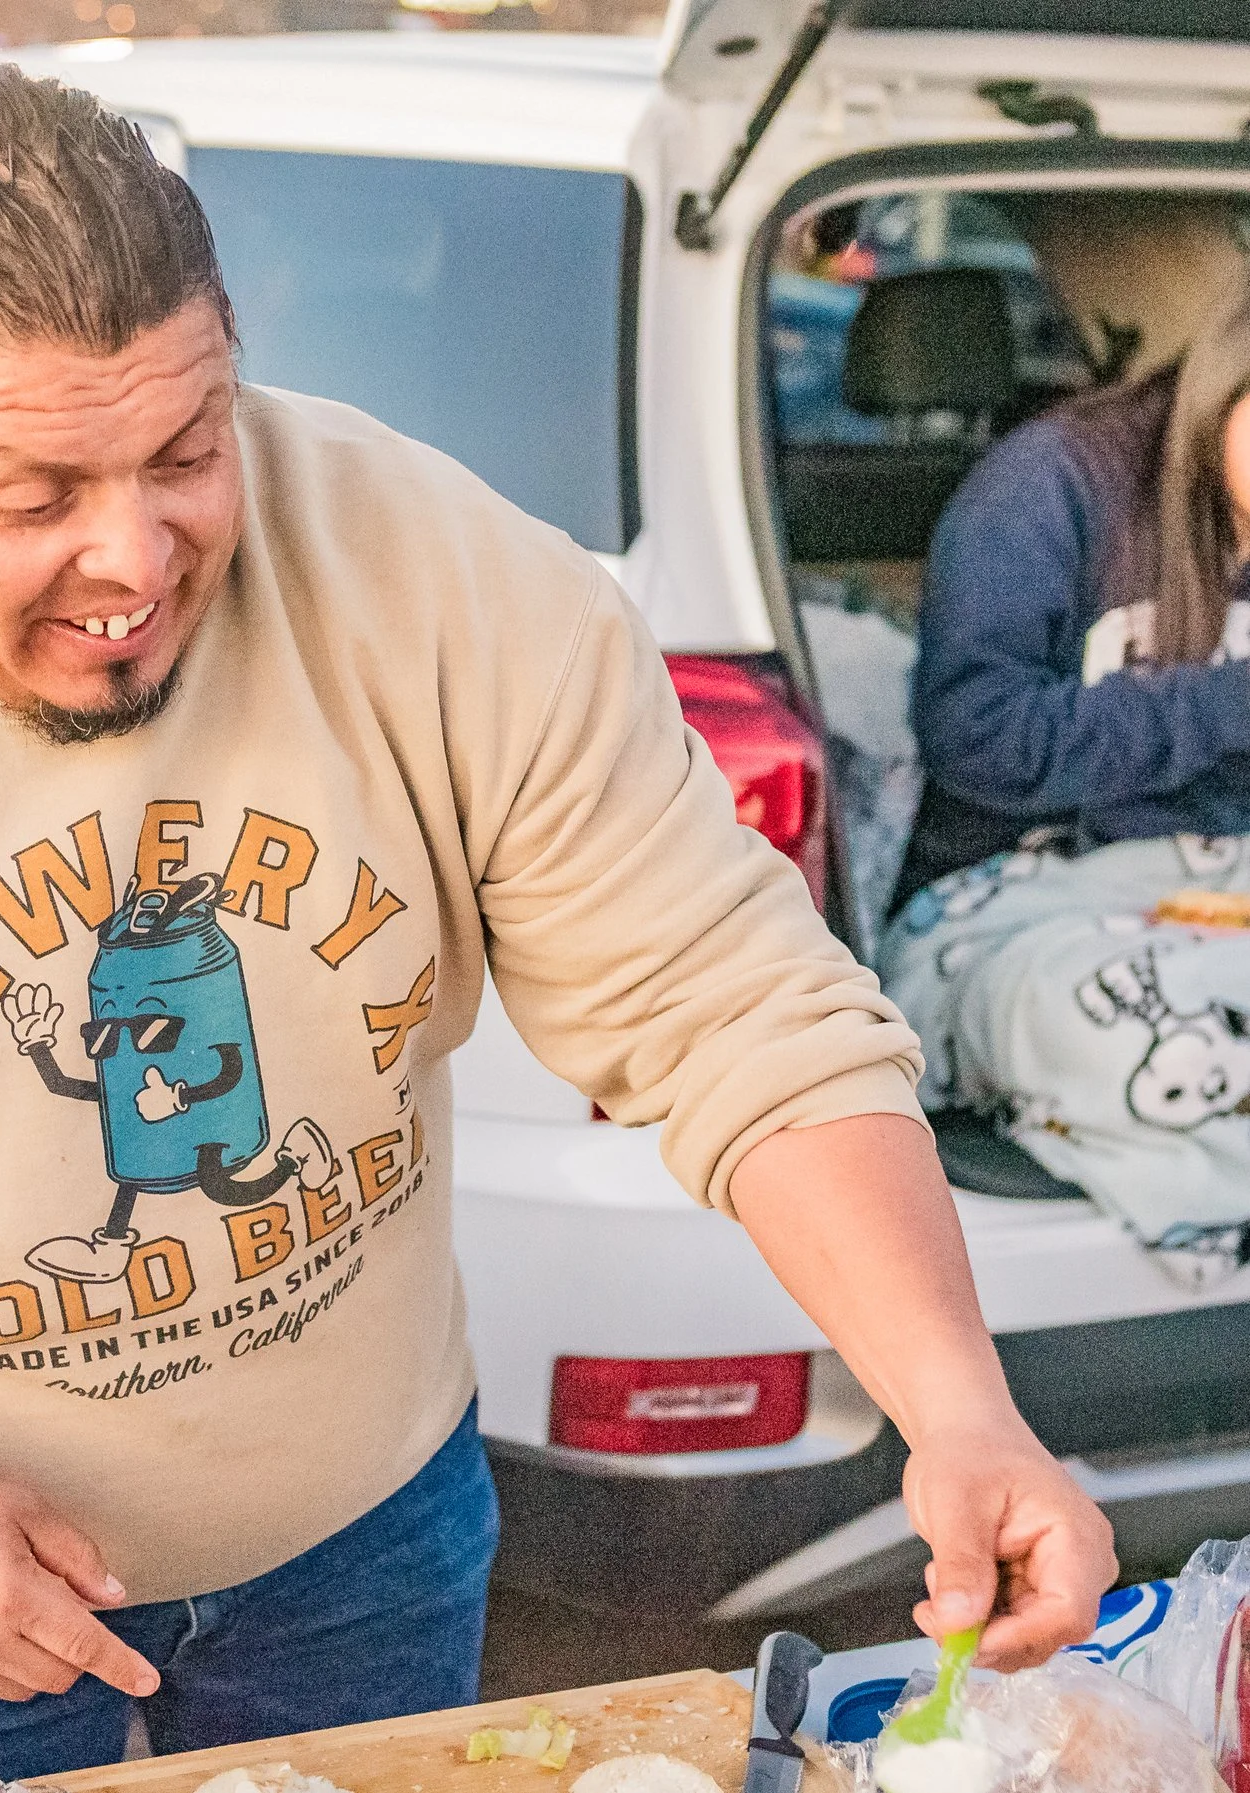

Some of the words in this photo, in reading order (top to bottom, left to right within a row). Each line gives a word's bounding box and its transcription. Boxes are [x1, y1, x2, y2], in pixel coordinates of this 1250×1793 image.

[81, 1336, 121, 1363] IN
[130, 1317, 202, 1350] THE
[211, 1286, 279, 1329] USA
[284, 1222, 365, 1295] SINCE
[371, 1168, 424, 1230] 2018
[219, 1102, 425, 1284] BEE
[227, 1253, 365, 1358] California
